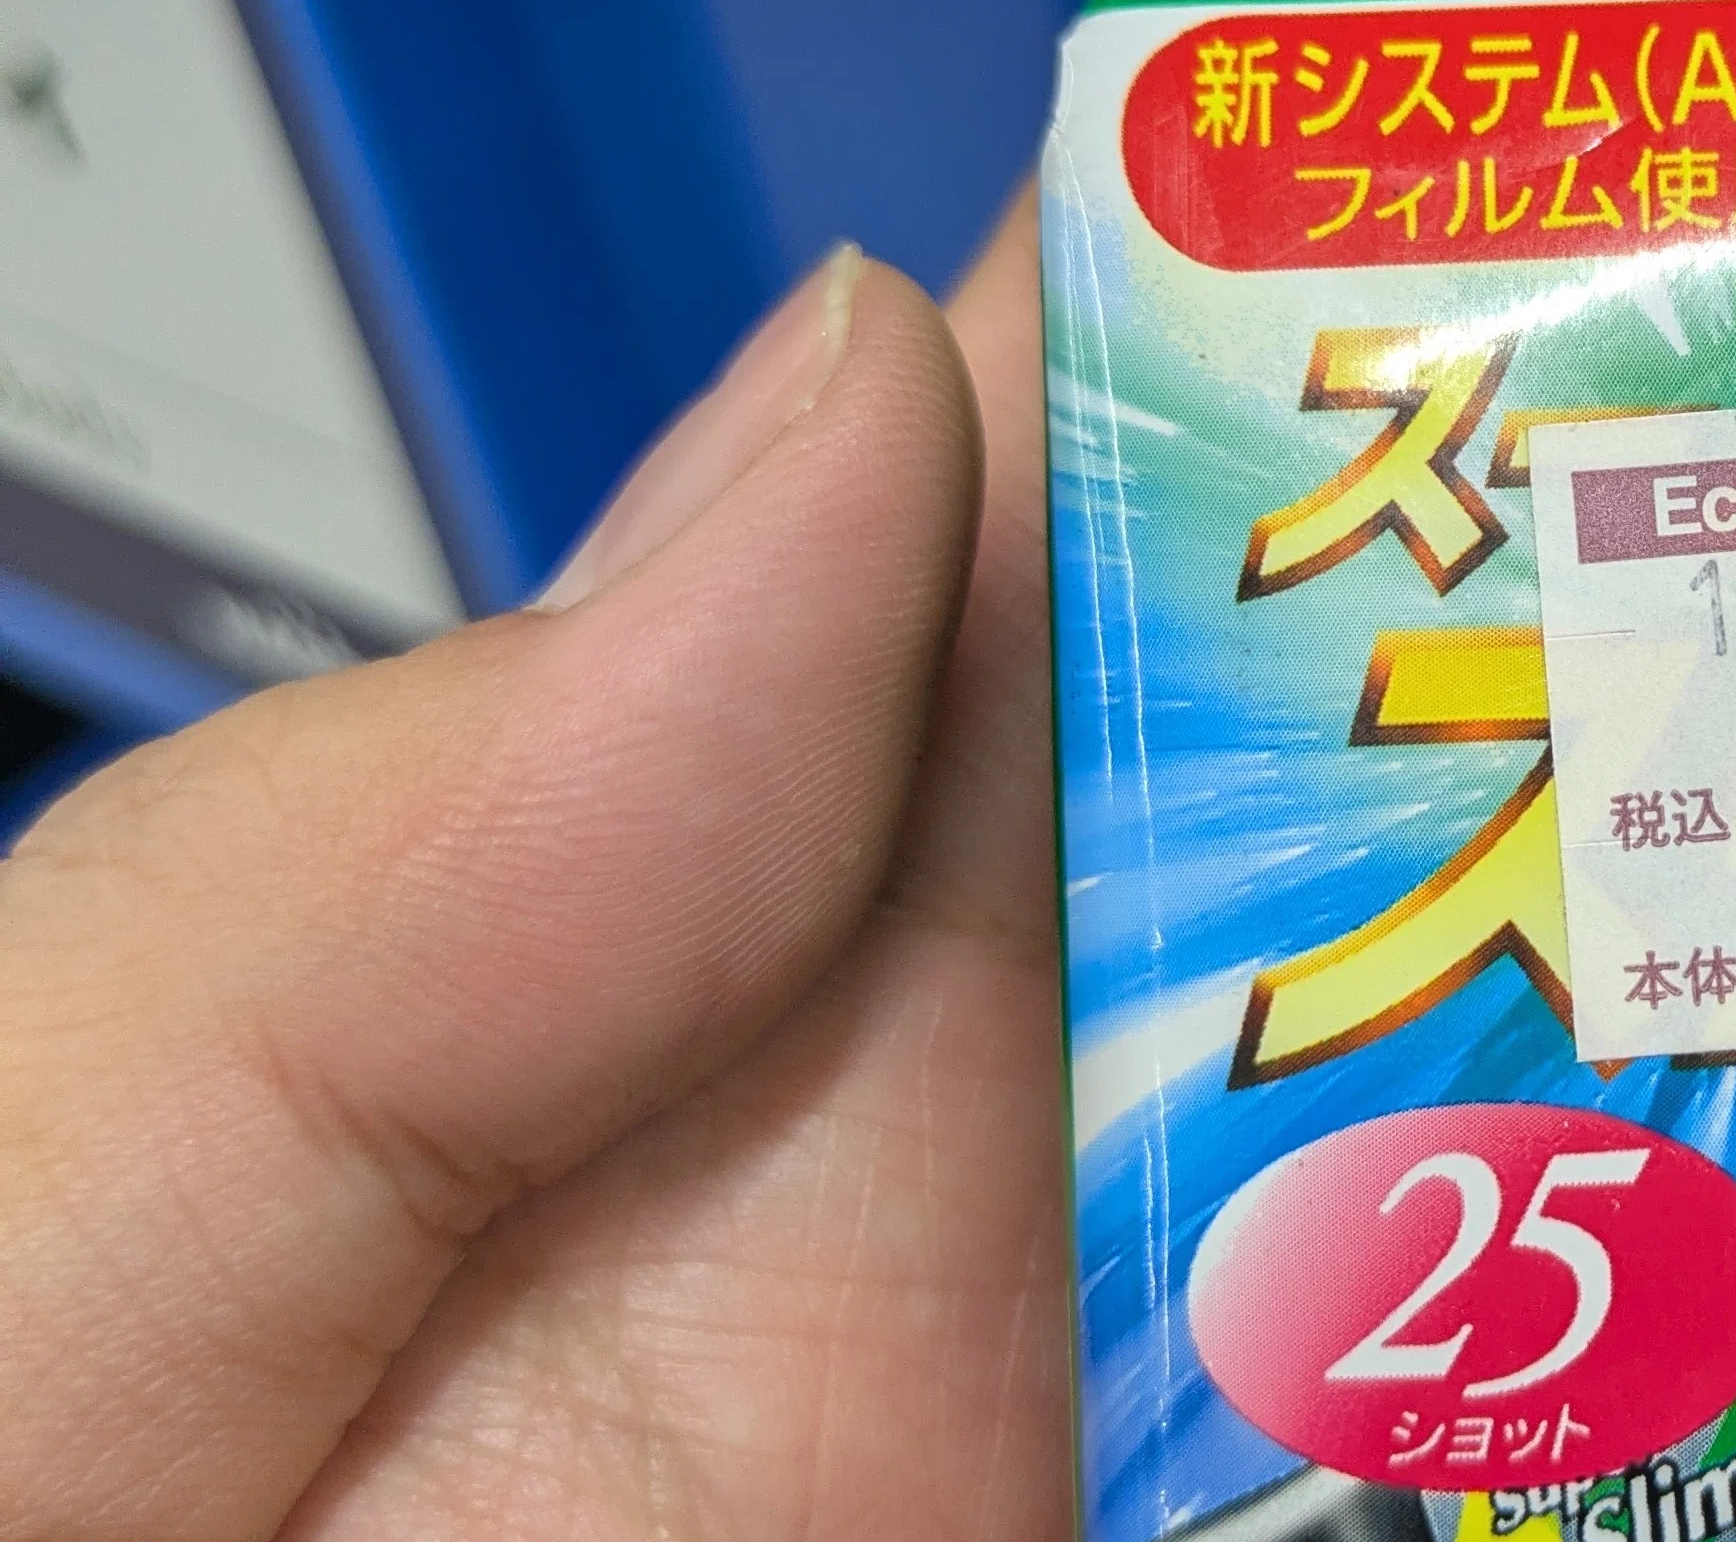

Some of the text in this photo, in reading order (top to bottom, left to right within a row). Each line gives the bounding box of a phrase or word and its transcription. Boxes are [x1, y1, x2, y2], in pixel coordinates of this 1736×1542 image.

[1609, 787, 1732, 851] 税込
[1324, 1148, 1650, 1399] 25
[1388, 1401, 1592, 1469] ショット
